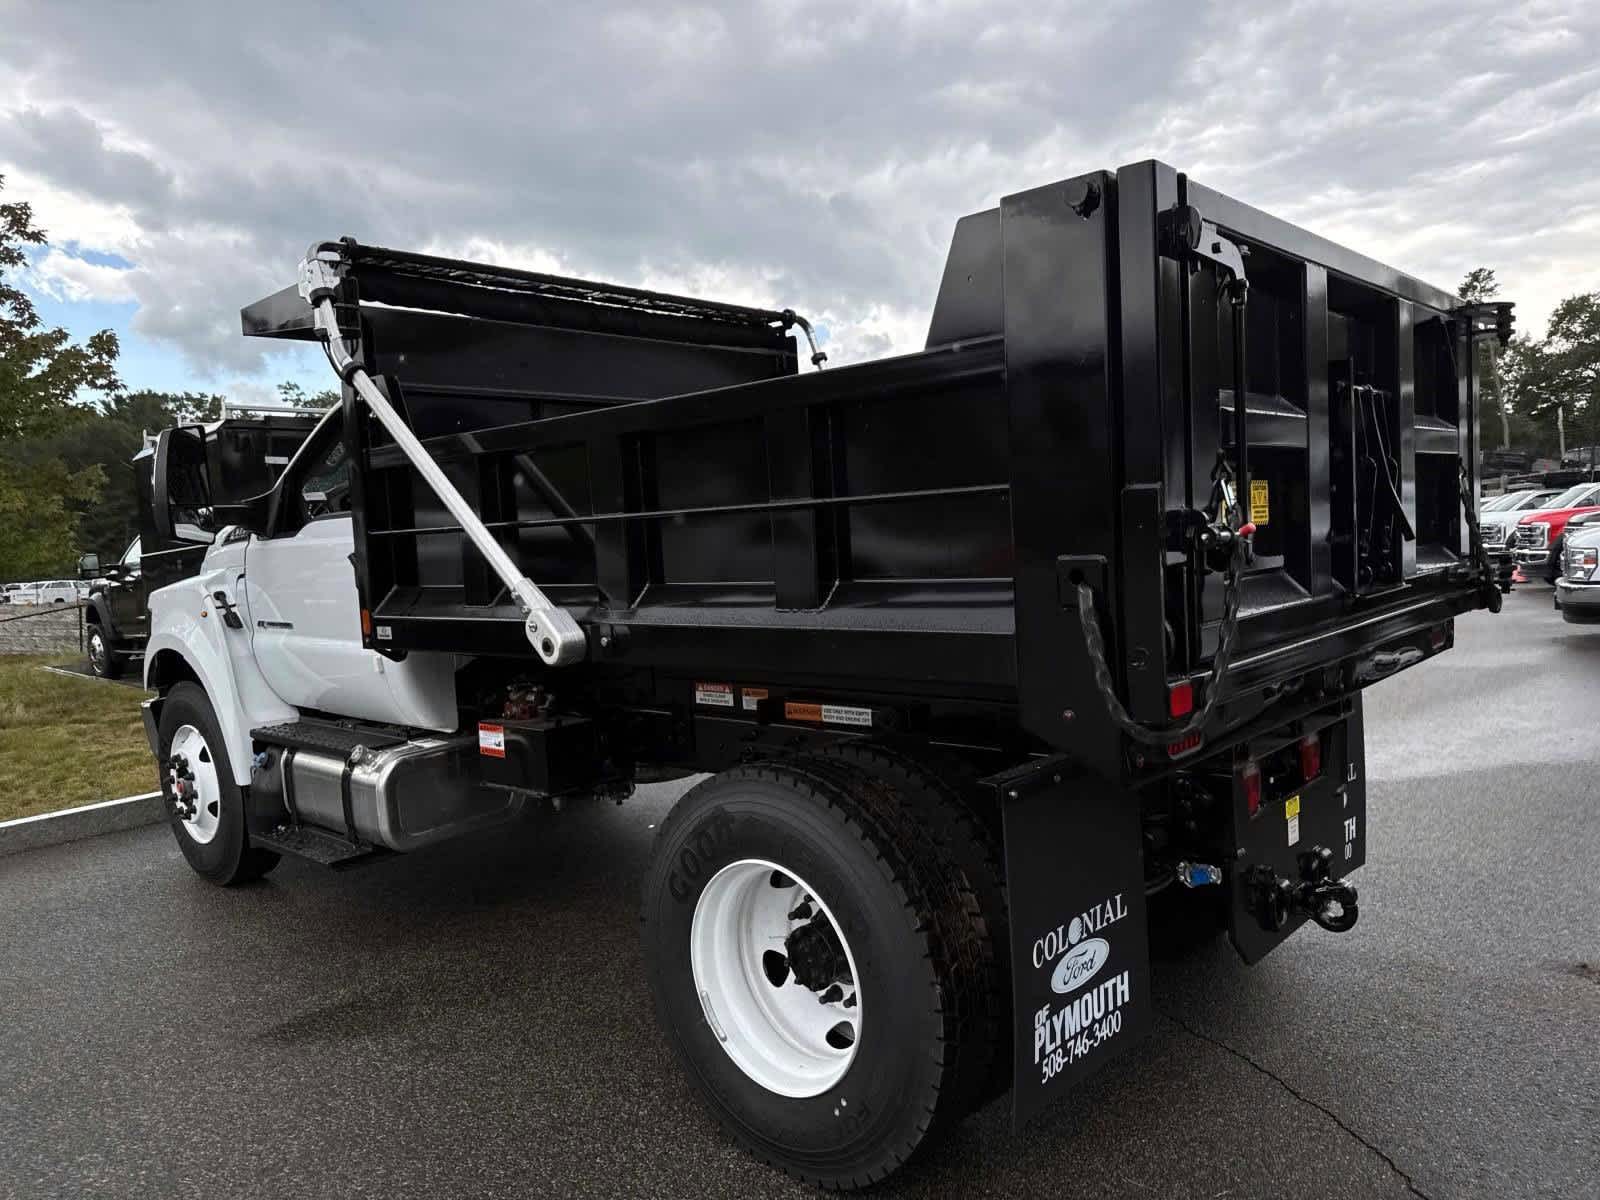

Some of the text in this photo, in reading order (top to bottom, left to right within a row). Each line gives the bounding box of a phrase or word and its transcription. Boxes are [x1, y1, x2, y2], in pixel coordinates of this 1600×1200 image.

[1063, 948, 1097, 986] Ford
[1034, 1003, 1051, 1029] OF
[1034, 970, 1130, 1065] PLYMOUTH
[1041, 1010, 1122, 1085] 508-746-3400
